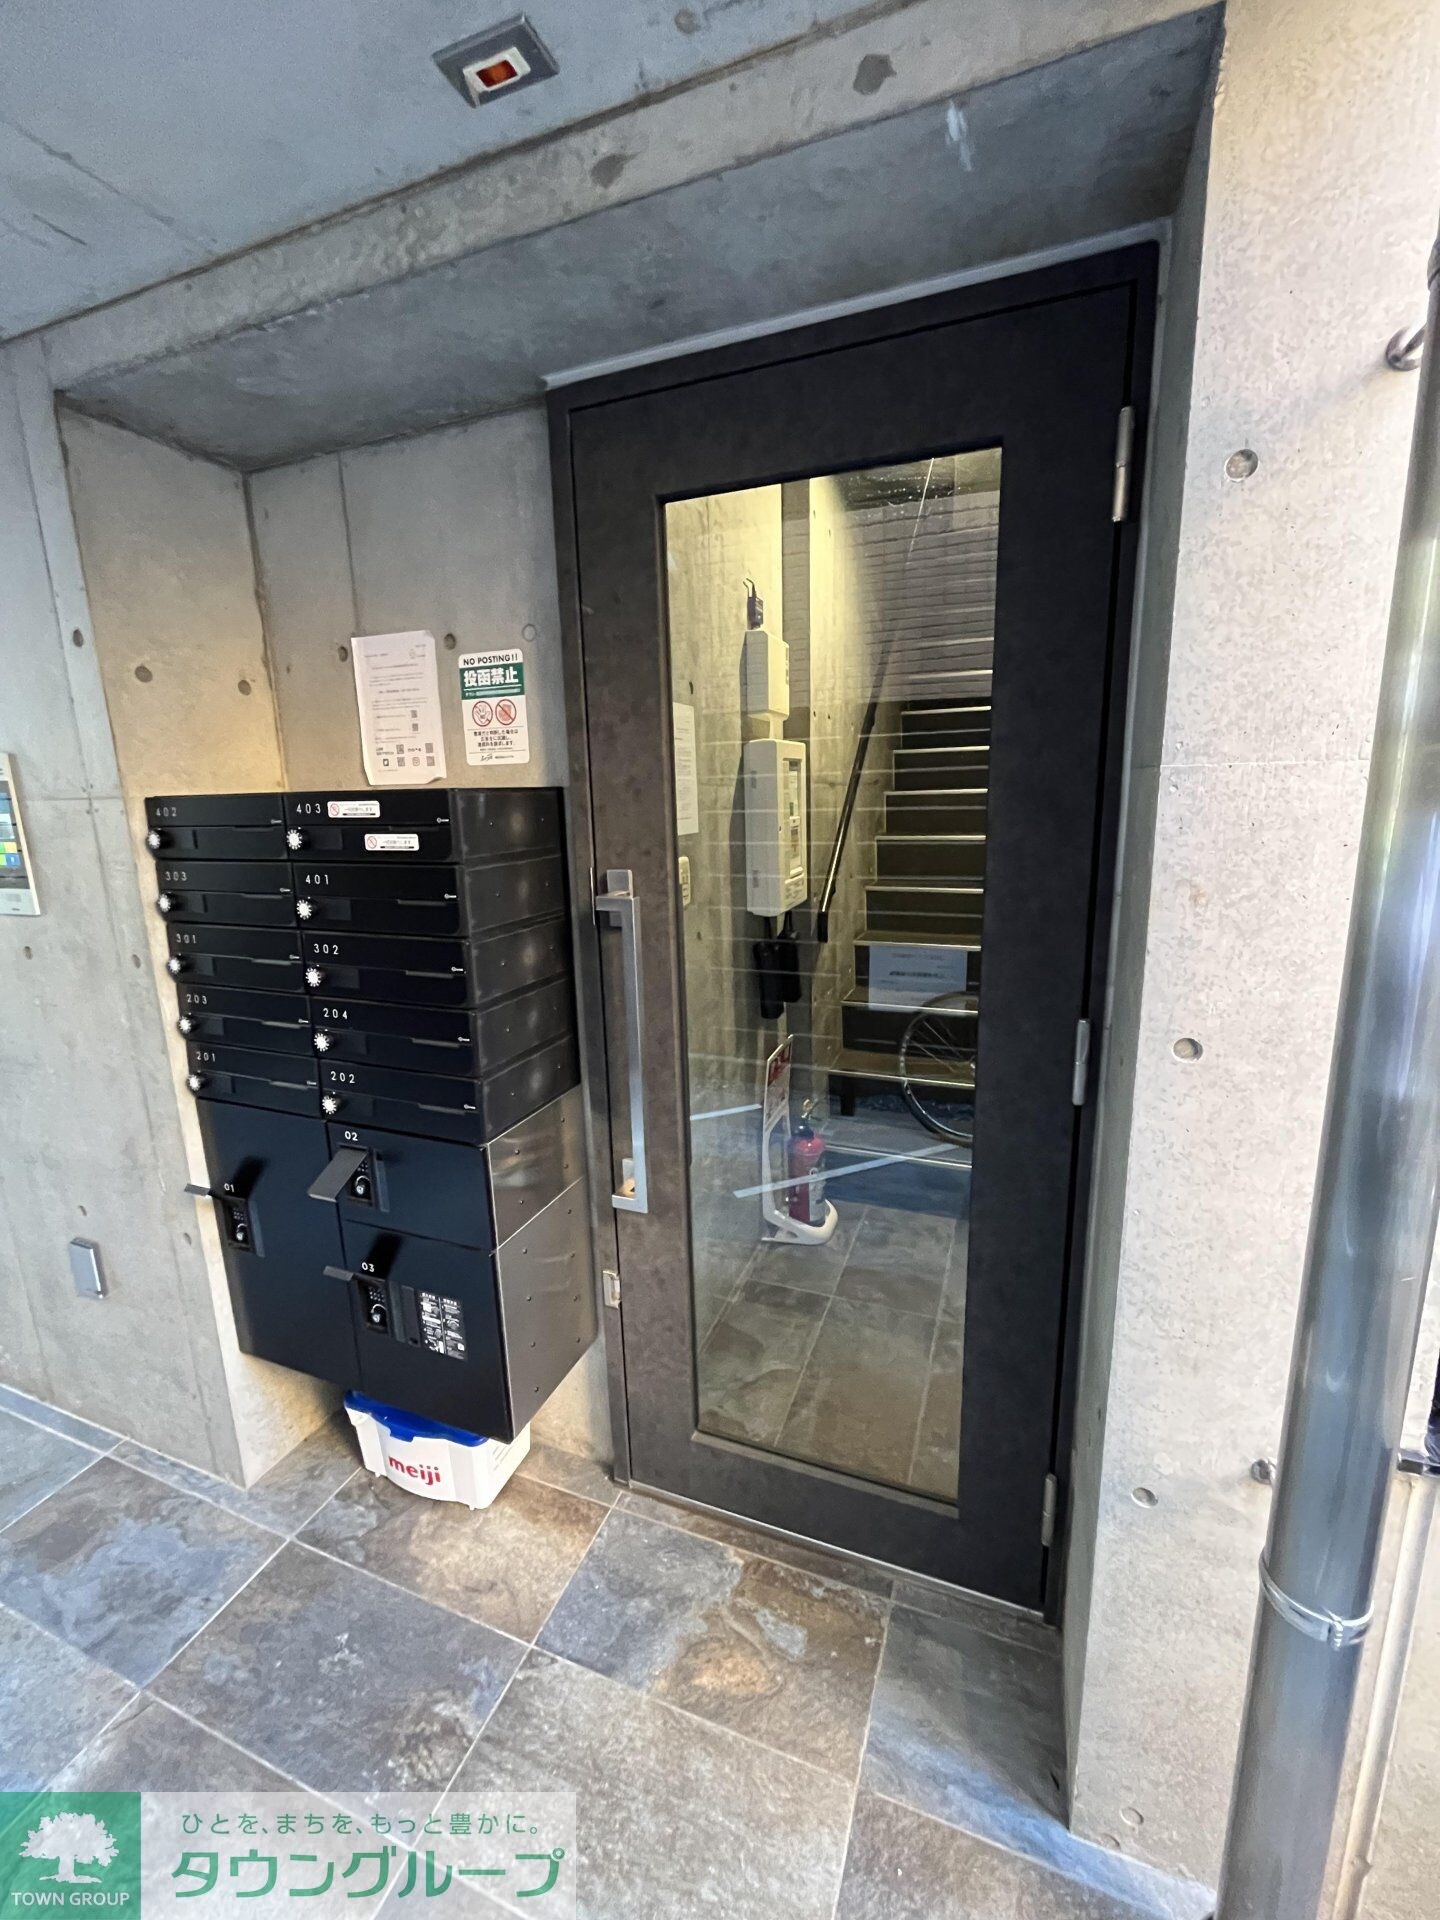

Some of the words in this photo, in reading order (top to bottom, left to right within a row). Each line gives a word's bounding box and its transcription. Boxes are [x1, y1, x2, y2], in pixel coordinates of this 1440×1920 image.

[463, 658, 476, 666] NO
[477, 653, 518, 665] POSTING!!
[463, 666, 519, 688] 投函禁止
[155, 806, 178, 817] 402
[296, 803, 321, 814] 403
[165, 871, 188, 882] 303
[305, 874, 329, 885] 401
[176, 933, 197, 944] 301
[313, 943, 339, 955] 302
[187, 993, 208, 1005] 203
[323, 1007, 348, 1020] 204
[196, 1050, 216, 1062] 201
[331, 1070, 356, 1084] 202
[344, 1130, 358, 1142] 02
[361, 1261, 375, 1273] 03
[388, 1456, 442, 1486] meiji
